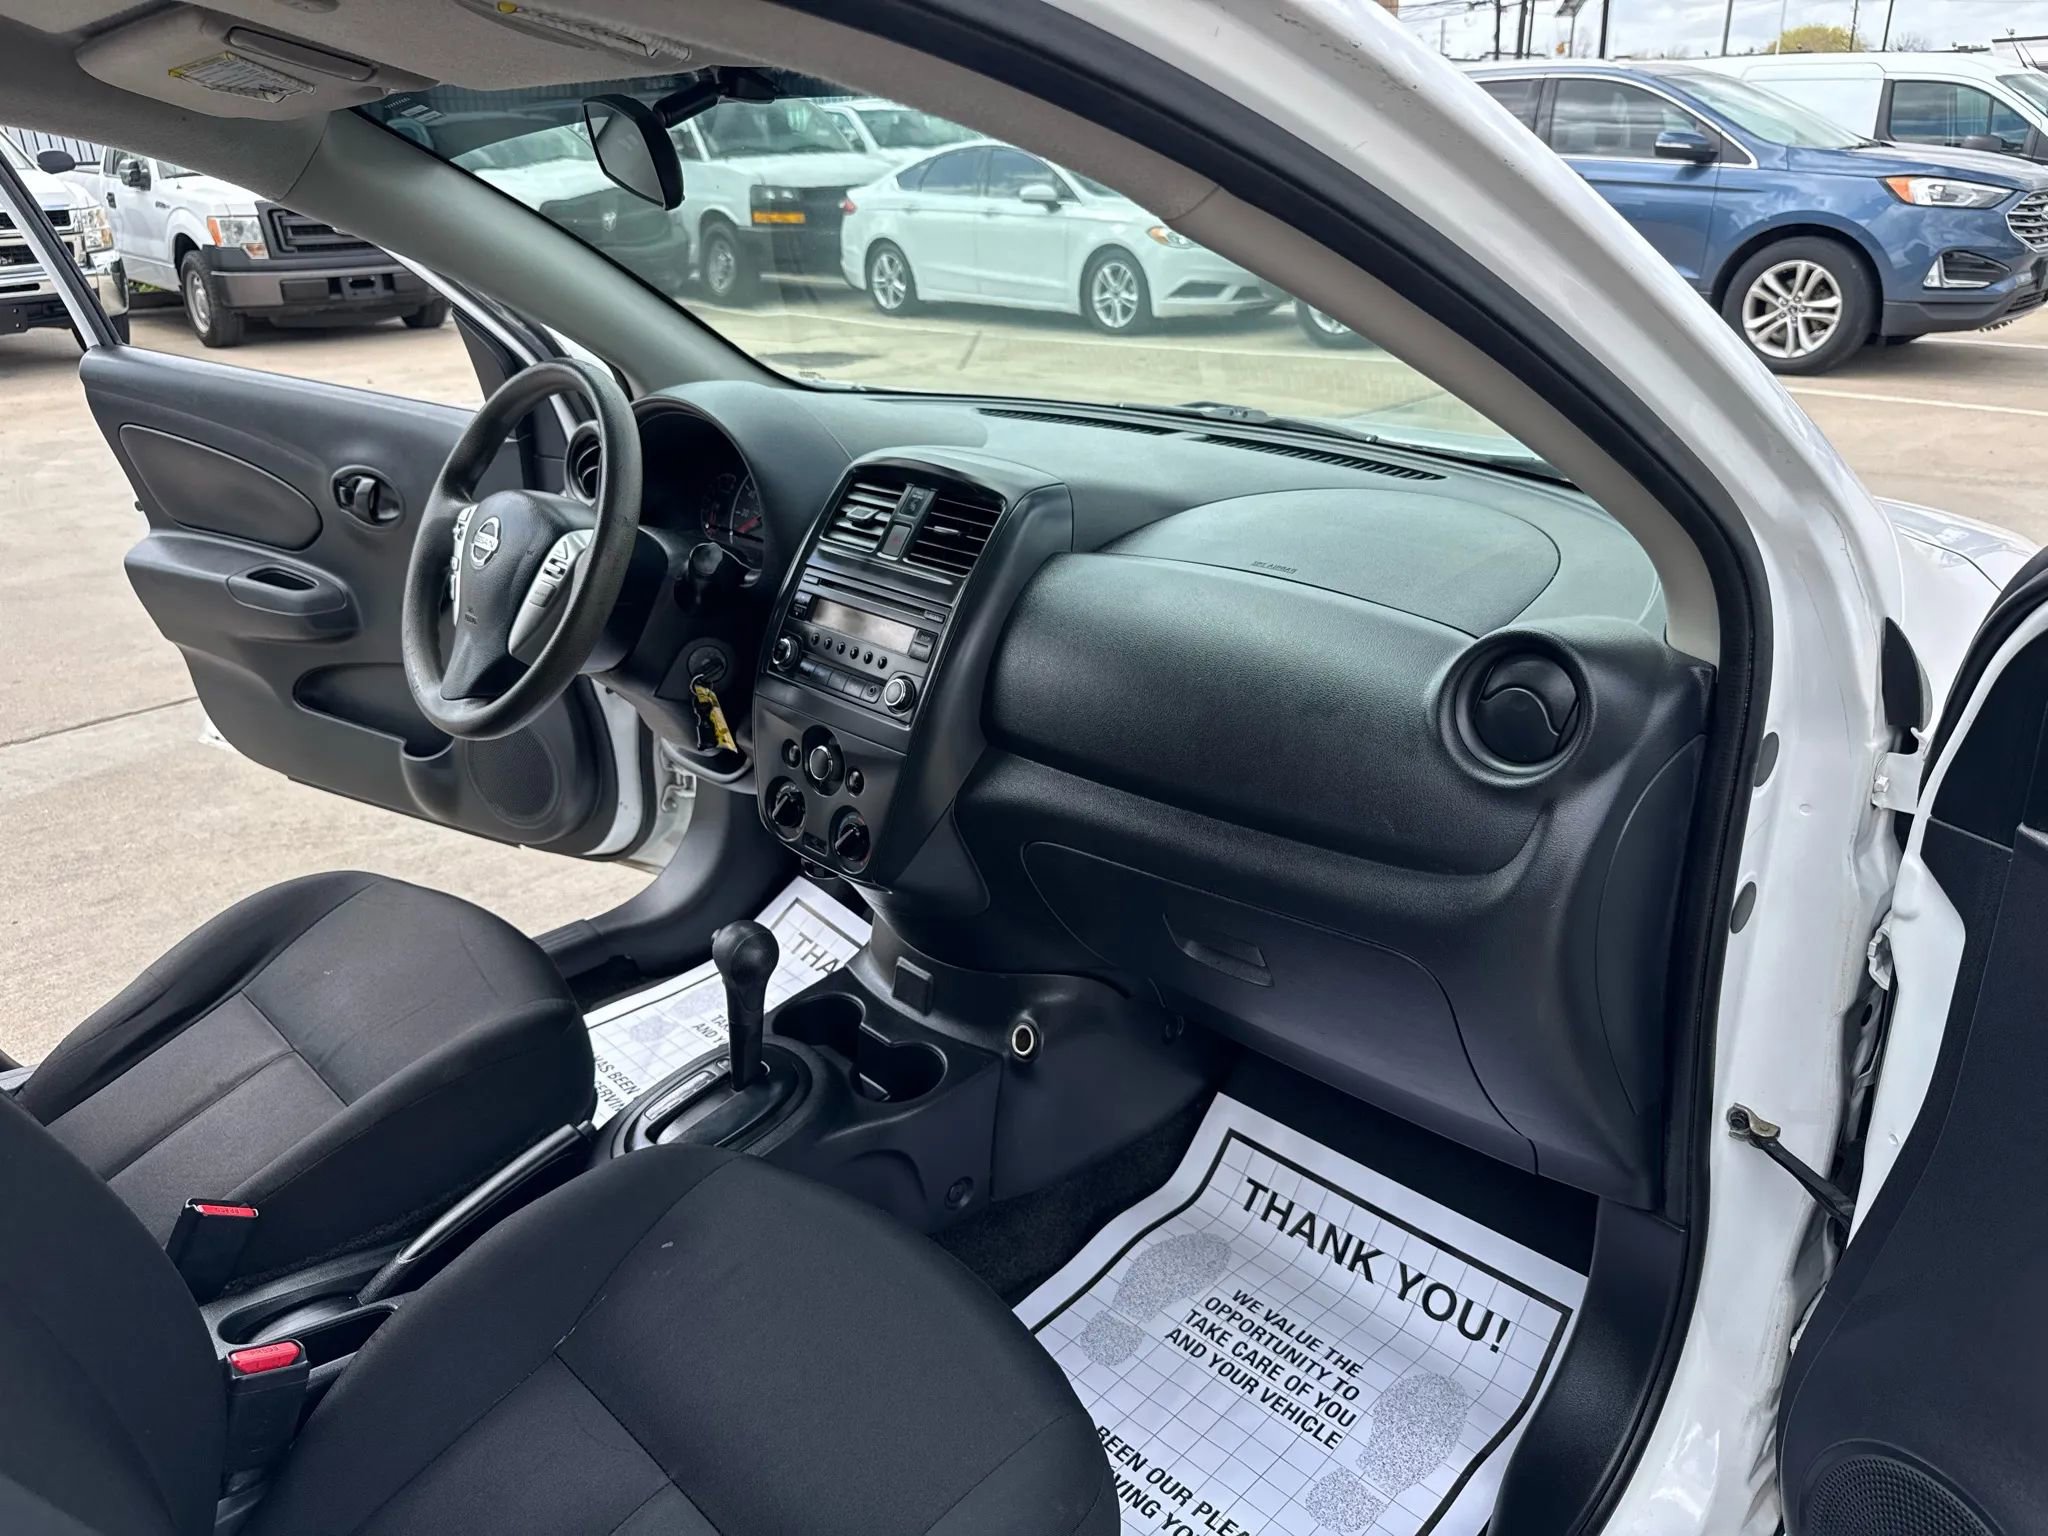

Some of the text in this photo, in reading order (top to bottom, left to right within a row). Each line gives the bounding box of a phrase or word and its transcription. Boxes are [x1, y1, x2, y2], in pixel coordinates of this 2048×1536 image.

[607, 1071, 641, 1095] BEEN
[1243, 1177, 1511, 1354] THANK YOU!
[1184, 1308, 1357, 1428] TAKE CARE OF YOU
[1204, 1296, 1361, 1401] OPPORTUNITY TO
[1232, 1289, 1364, 1378] WE VALUE THE
[1165, 1327, 1344, 1450] AND YOUR VEHICLE
[1096, 1425, 1149, 1472] BEEN
[1145, 1467, 1194, 1507] OUR
[1111, 1466, 1200, 1536] VING YO
